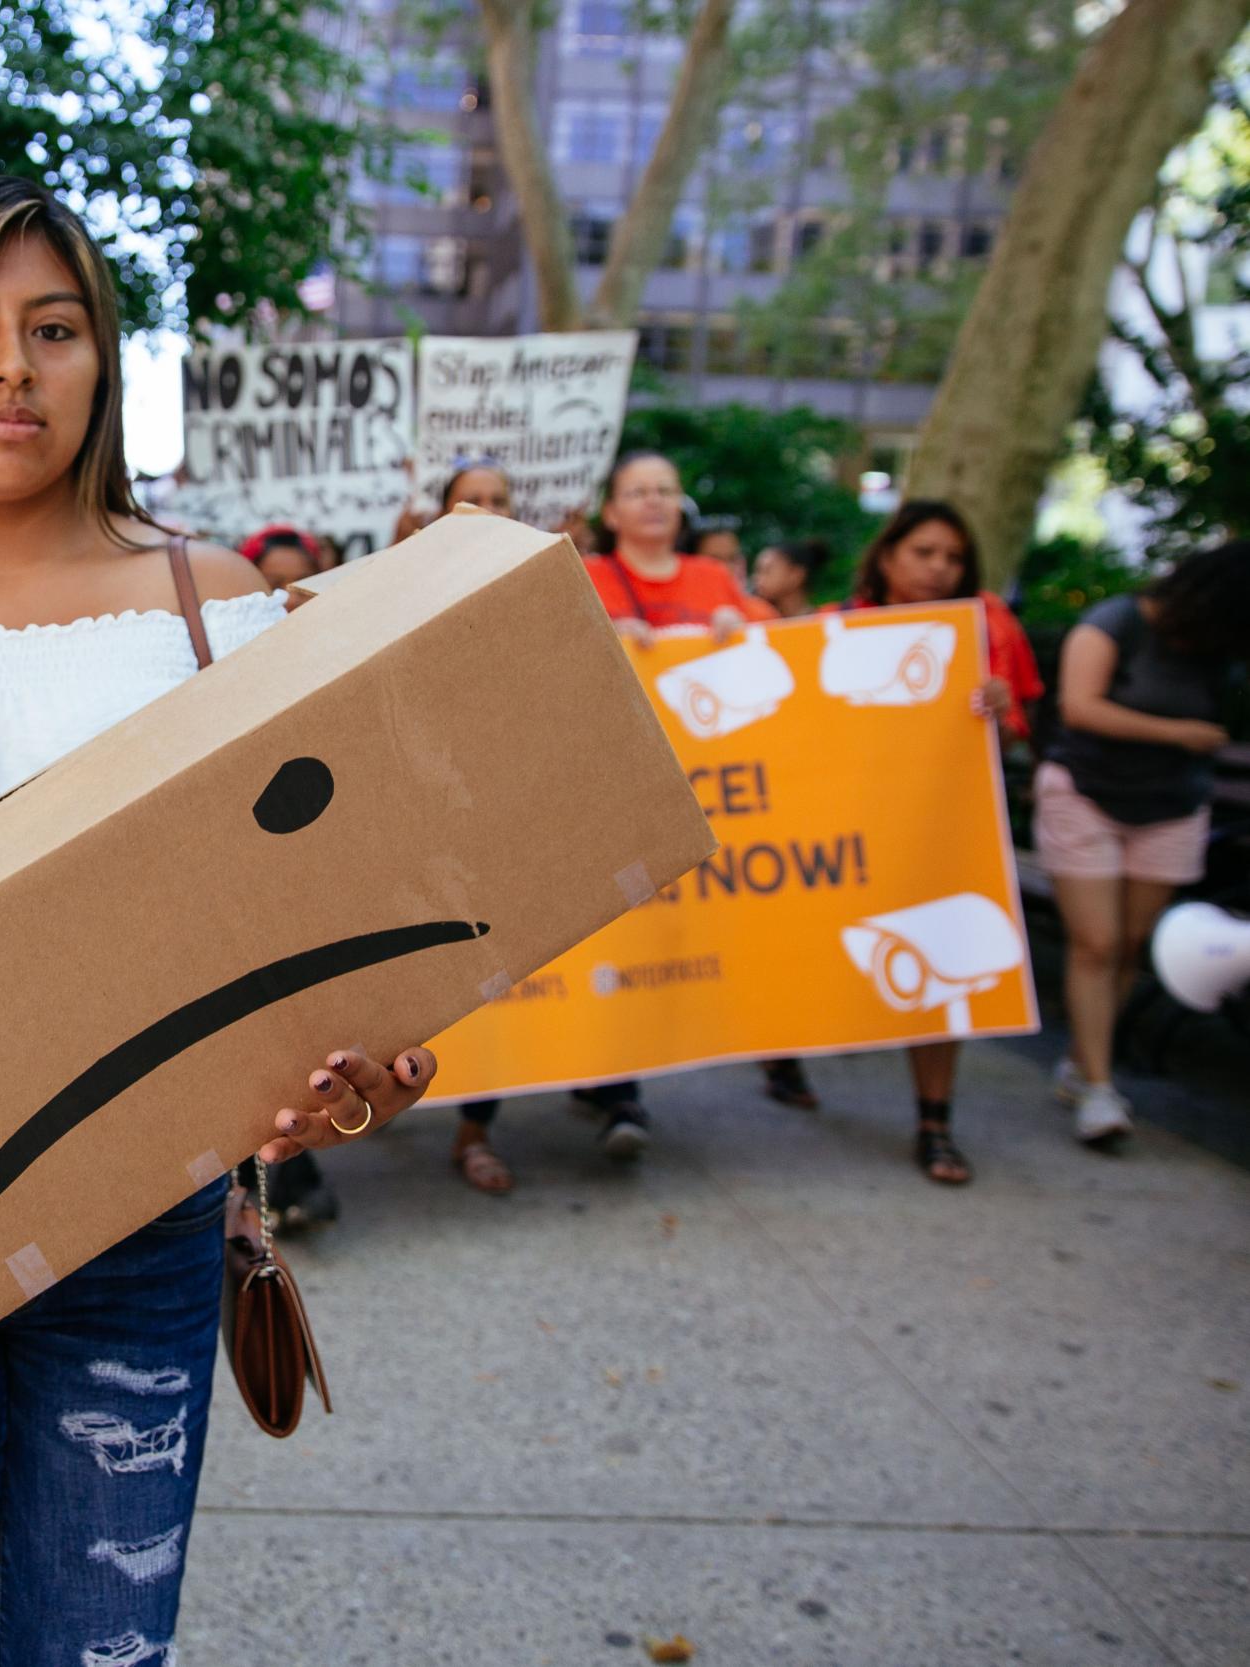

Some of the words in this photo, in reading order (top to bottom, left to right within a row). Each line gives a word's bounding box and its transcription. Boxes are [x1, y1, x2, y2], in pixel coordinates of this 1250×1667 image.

[182, 354, 241, 411] NO
[254, 346, 400, 418] SOMOS
[697, 833, 868, 900] NOW!
